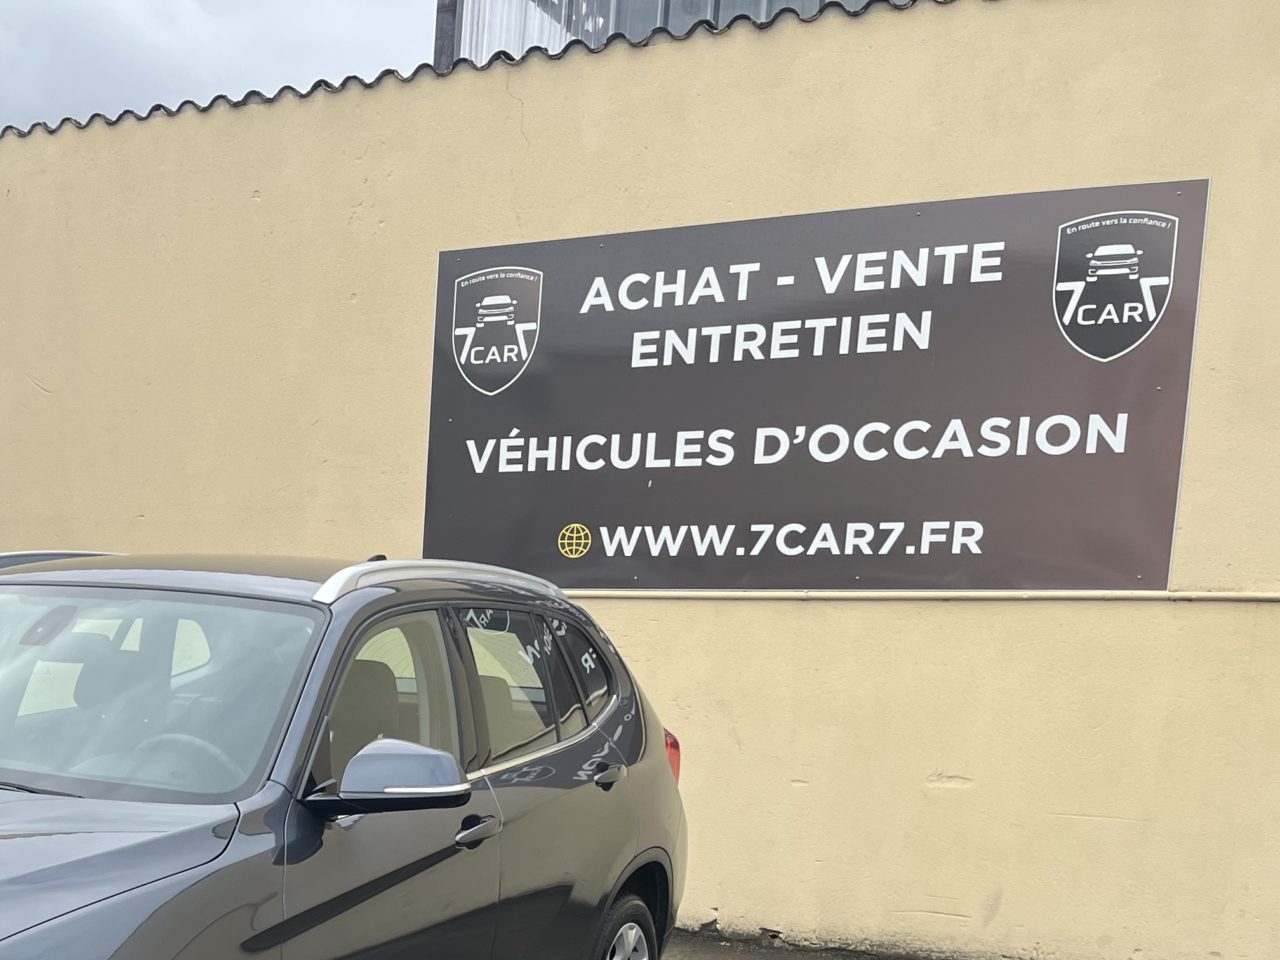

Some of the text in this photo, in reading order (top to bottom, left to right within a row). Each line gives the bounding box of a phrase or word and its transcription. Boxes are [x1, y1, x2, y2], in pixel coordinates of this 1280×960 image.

[1078, 221, 1100, 230] route
[1102, 218, 1118, 226] vers
[1128, 217, 1166, 228] confiance
[469, 276, 485, 284] route
[506, 272, 534, 281] confiance
[580, 263, 760, 313] ACHAT
[815, 241, 1006, 294] VENTE
[630, 311, 933, 368] ENTRETIEN
[466, 428, 735, 473] VÉHICULES
[600, 521, 984, 557] WWW.7CAR7.FR
